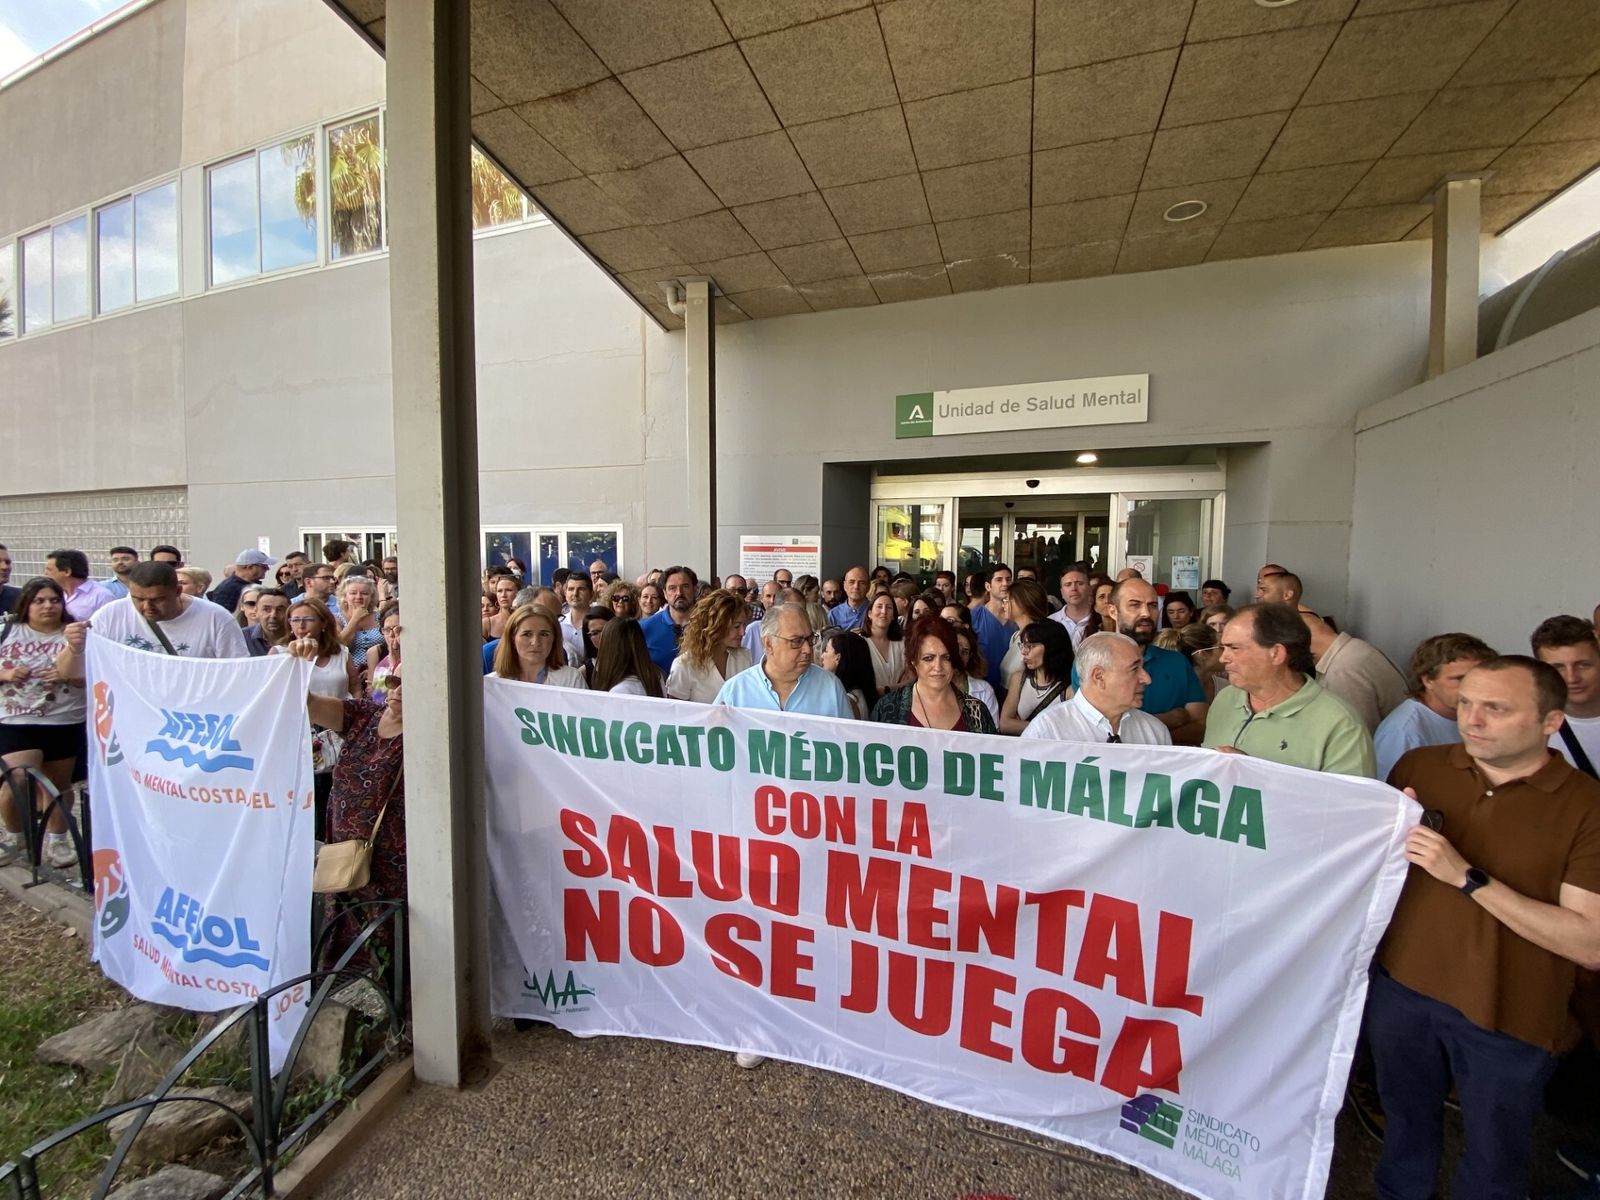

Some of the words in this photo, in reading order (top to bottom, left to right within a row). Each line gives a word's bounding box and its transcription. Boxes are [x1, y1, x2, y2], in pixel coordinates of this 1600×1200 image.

[938, 401, 994, 418] Unidad
[1000, 400, 1020, 414] de
[1026, 394, 1076, 411] Salud
[1082, 388, 1142, 408] Mental
[157, 707, 242, 752] AFESOL
[143, 773, 188, 800] MENTAL
[188, 787, 247, 805] COSTA
[247, 791, 277, 810] EL
[514, 707, 736, 772] SINDICATO
[748, 731, 929, 791] MÉDICO
[943, 750, 1005, 803] DE
[1019, 756, 1267, 850] MÁLAGA
[754, 785, 857, 845] CON
[871, 798, 933, 859] LA
[559, 808, 801, 918] SALUD
[825, 849, 1204, 1018] MENTAL
[133, 933, 161, 965] SALUD
[160, 955, 202, 989] MENTAL
[204, 977, 261, 1001] COSTA
[563, 887, 685, 968] NO
[704, 912, 817, 1003] SE
[840, 939, 1184, 1099] JUEGA
[1185, 1126, 1239, 1158] MÉDICO
[1187, 1109, 1260, 1152] SINDICATO
[1183, 1142, 1241, 1182] MÁLAGA
